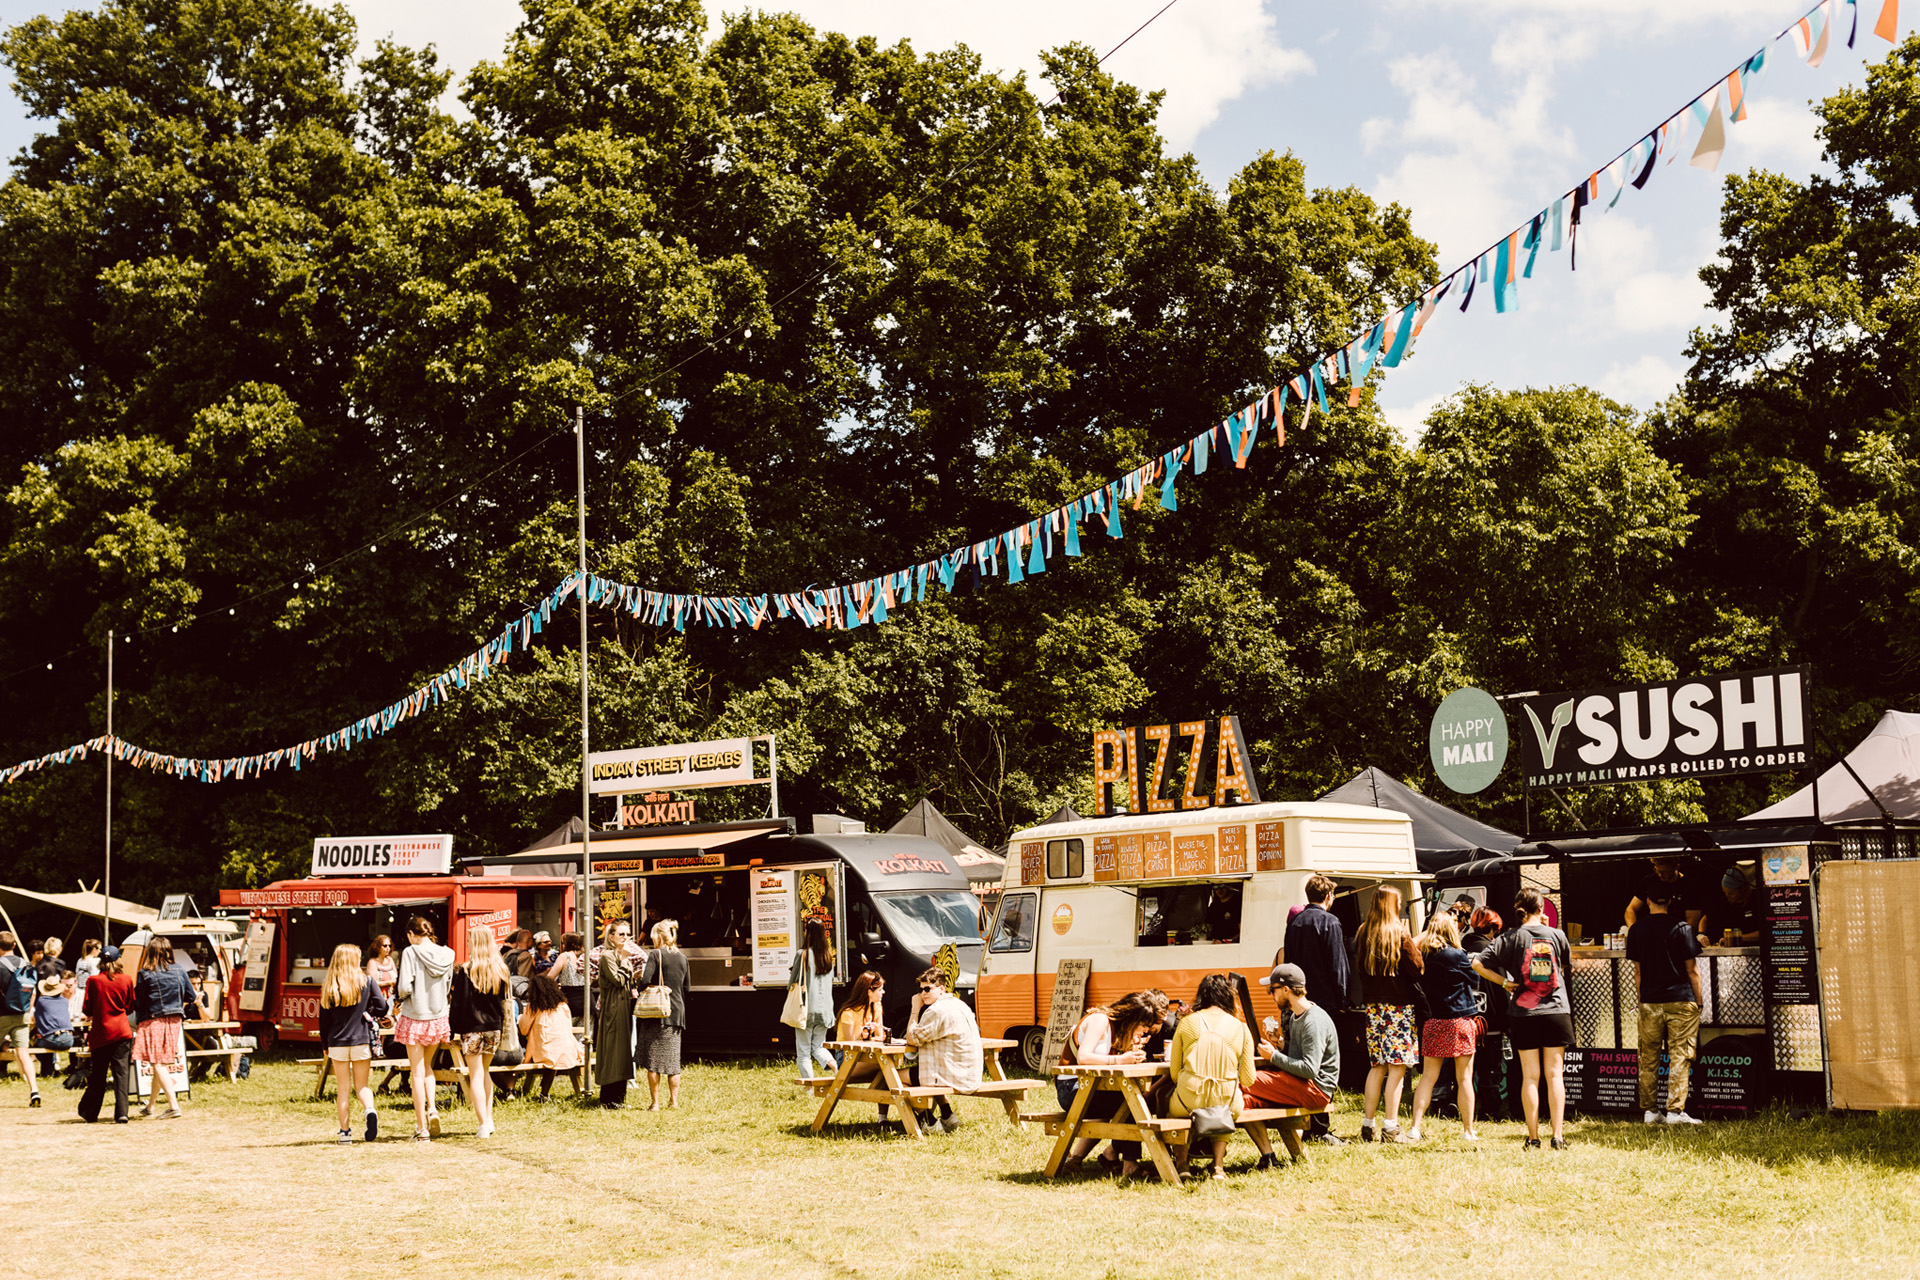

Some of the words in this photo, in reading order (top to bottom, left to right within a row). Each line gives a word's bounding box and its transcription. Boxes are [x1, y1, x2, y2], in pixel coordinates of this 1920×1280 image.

[1441, 717, 1494, 741] HAPPY
[1442, 741, 1494, 766] MAKI
[593, 761, 634, 781] INDIAN
[636, 756, 688, 777] STREET
[690, 750, 743, 772] KEBABS
[1094, 715, 1256, 815] PIZZA
[1529, 773, 1573, 787] HAPPY
[1577, 769, 1612, 783] MAKI
[1616, 763, 1666, 779] WRAPS
[1671, 759, 1725, 774] ROLLED
[1729, 757, 1750, 769] TO
[1754, 751, 1807, 767] ORDER
[621, 800, 696, 827] KOLKATI
[1225, 835, 1236, 844] NO
[1258, 831, 1280, 841] PIZZA
[1022, 843, 1043, 857] PIZZA
[1146, 841, 1168, 852] PIZZA
[1178, 840, 1195, 850] WHERE
[1196, 839, 1206, 848] THE
[318, 844, 392, 868] NOODLES
[1094, 853, 1116, 869] PIZZA
[1121, 853, 1142, 865] PIZZA
[1183, 850, 1199, 860] MAGIC
[1258, 850, 1283, 862] OPINION
[873, 859, 952, 876] KOLKATI
[1021, 856, 1041, 869] NEVER
[1146, 857, 1168, 872] CRUST
[1179, 859, 1207, 873] HAPPENS
[1220, 854, 1245, 871] PIZZA
[1023, 868, 1041, 882] LIES!
[1121, 864, 1140, 878] TIME
[240, 891, 291, 905] VIETNAMESE
[292, 890, 323, 904] STREET
[324, 890, 349, 904] FOOD
[469, 909, 512, 927] NOODLES
[497, 925, 511, 936] MI
[1591, 1053, 1613, 1062] THAI
[1616, 1053, 1638, 1062] SWE
[1700, 1055, 1752, 1066] AVOCADO
[1600, 1066, 1638, 1075] POTATO
[1707, 1068, 1743, 1078] K.I.S.S.
